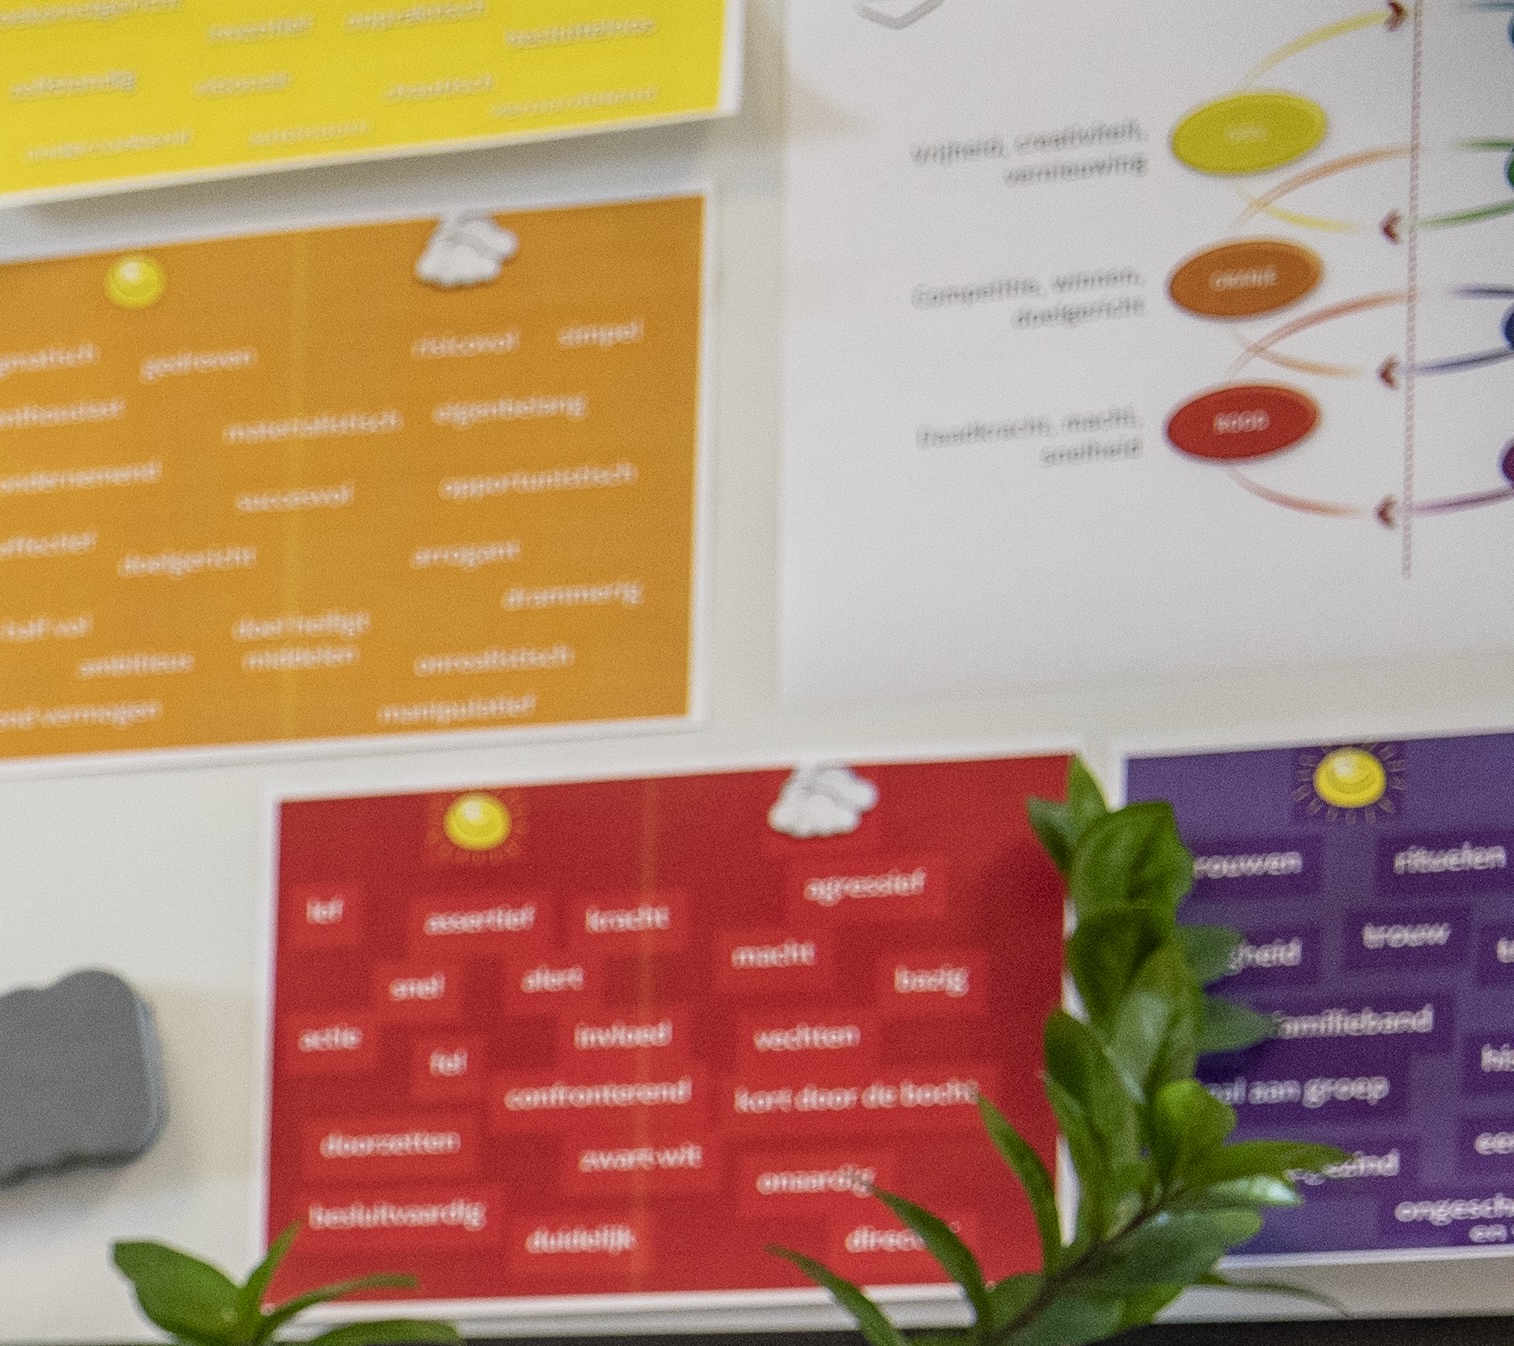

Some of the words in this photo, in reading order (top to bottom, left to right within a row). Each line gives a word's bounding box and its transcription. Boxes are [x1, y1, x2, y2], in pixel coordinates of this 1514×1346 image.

[1395, 843, 1506, 872] rituelen
[806, 870, 925, 903] agressief
[425, 907, 534, 934] assertief
[586, 906, 669, 931] kracht
[1363, 924, 1450, 948] trouw
[732, 943, 814, 966] macht
[391, 976, 444, 999] snel
[523, 968, 583, 991] alert
[895, 969, 967, 995] bazig
[1271, 1004, 1433, 1039] amilieband
[300, 1027, 361, 1050] actie
[575, 1023, 672, 1047] invloed
[755, 1026, 860, 1050] vechten
[505, 1080, 691, 1109] confronterend
[736, 1090, 793, 1112] kort
[794, 1087, 857, 1110] door
[860, 1085, 898, 1107] de
[1247, 1081, 1301, 1103] aan
[1302, 1077, 1389, 1105] groep
[321, 1132, 460, 1156] doorzetten
[309, 1200, 485, 1229] besluitvaardig
[527, 1227, 636, 1252] duidelijk
